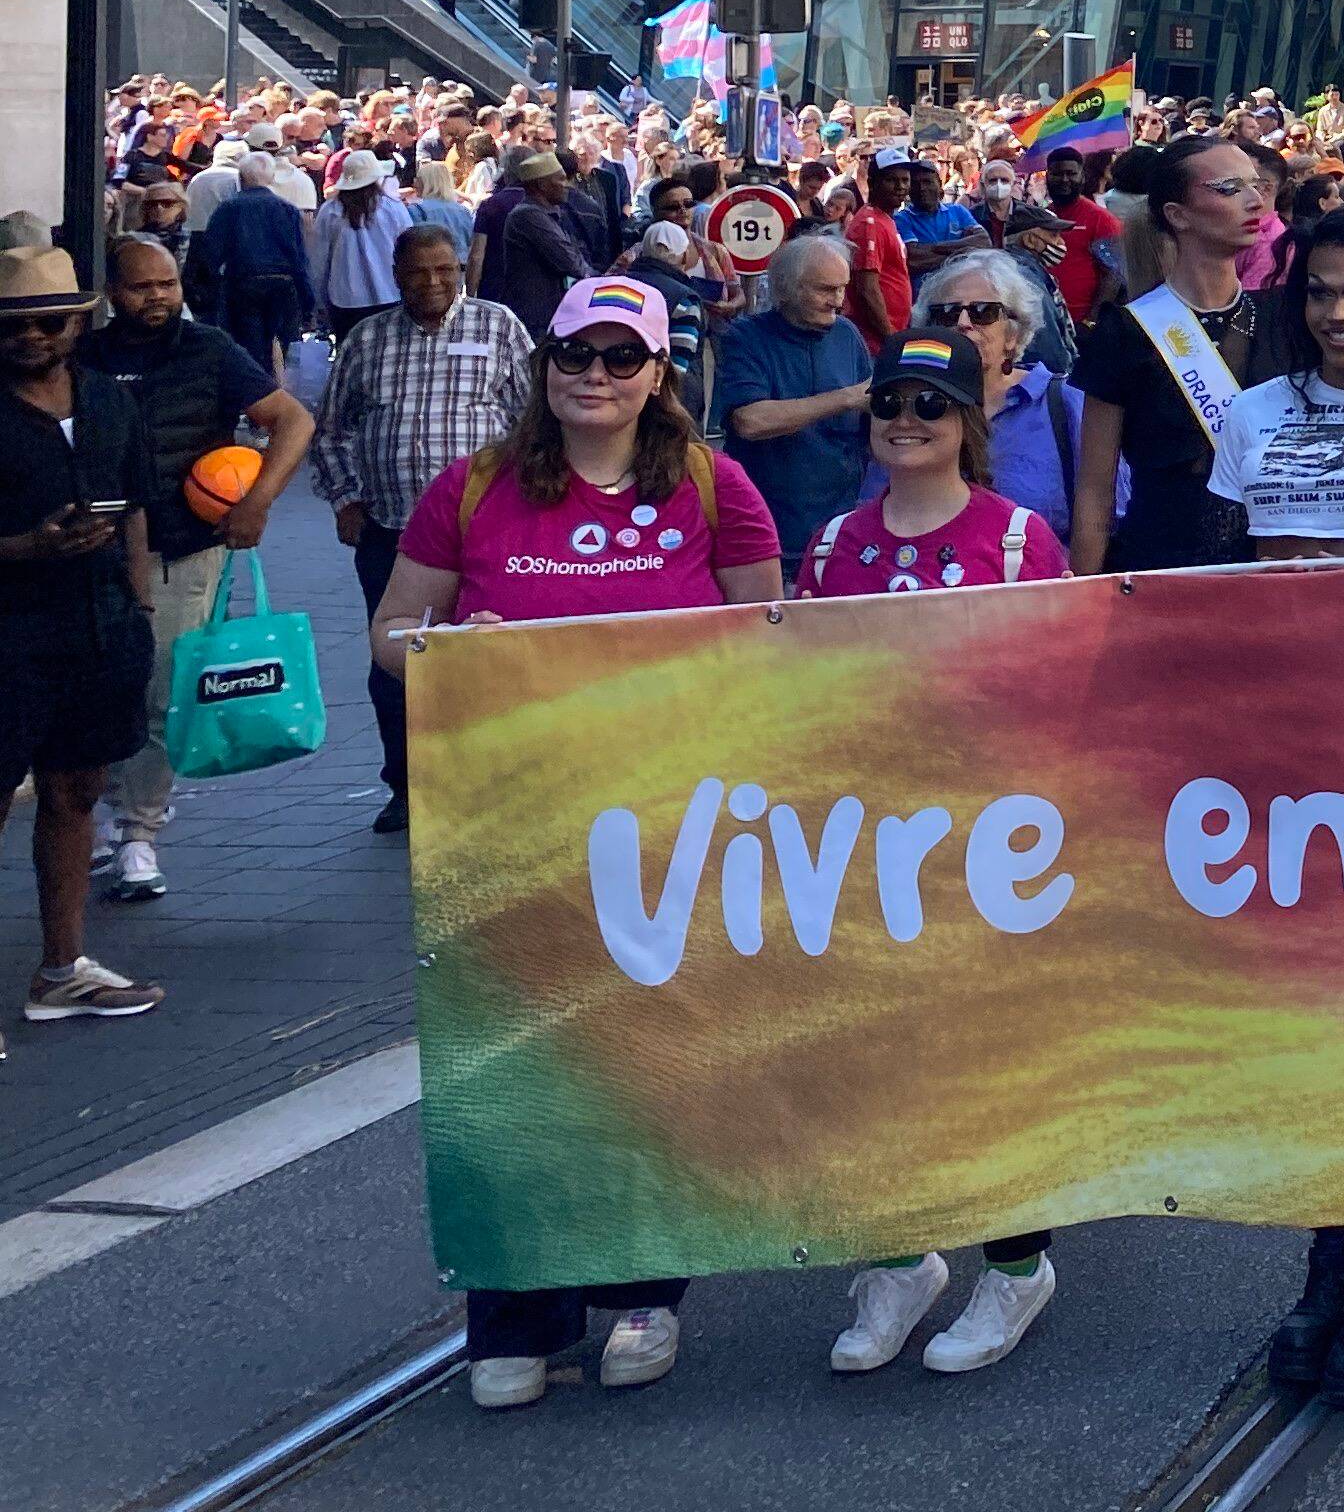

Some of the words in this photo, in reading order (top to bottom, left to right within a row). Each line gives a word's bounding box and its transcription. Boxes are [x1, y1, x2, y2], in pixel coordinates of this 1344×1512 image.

[949, 24, 967, 36] UNI
[949, 36, 968, 48] QLO
[732, 220, 759, 241] 19
[763, 225, 772, 240] t
[1182, 369, 1225, 433] DRAG'S
[1253, 495, 1281, 506] SURF
[1288, 493, 1320, 503] SKIM
[505, 554, 665, 576] SOShomophobie
[204, 666, 276, 697] Normal
[588, 777, 1075, 986] Vivre
